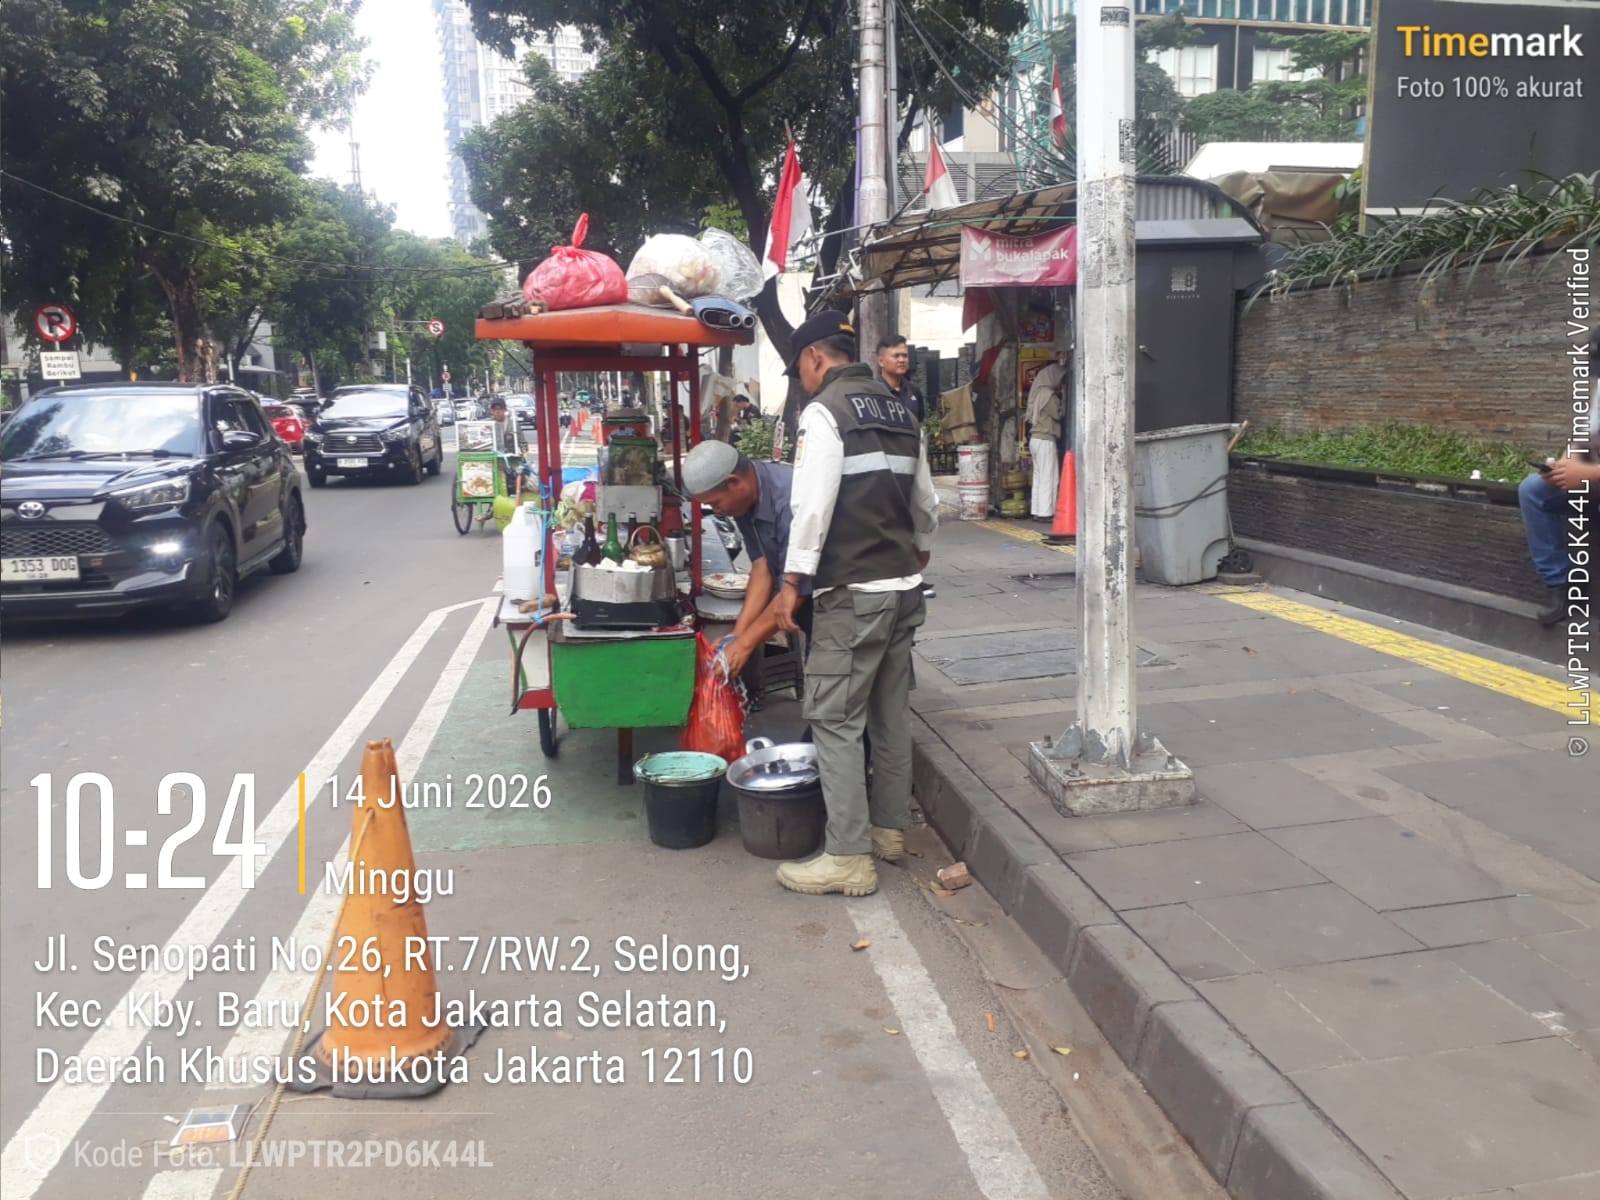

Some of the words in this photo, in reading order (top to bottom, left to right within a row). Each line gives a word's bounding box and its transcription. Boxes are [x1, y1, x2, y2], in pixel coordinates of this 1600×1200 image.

[996, 248, 1069, 262] bukalapak
[851, 397, 887, 420] POL
[886, 400, 905, 423] PP
[11, 558, 45, 574] 1353
[51, 557, 77, 572] DOG
